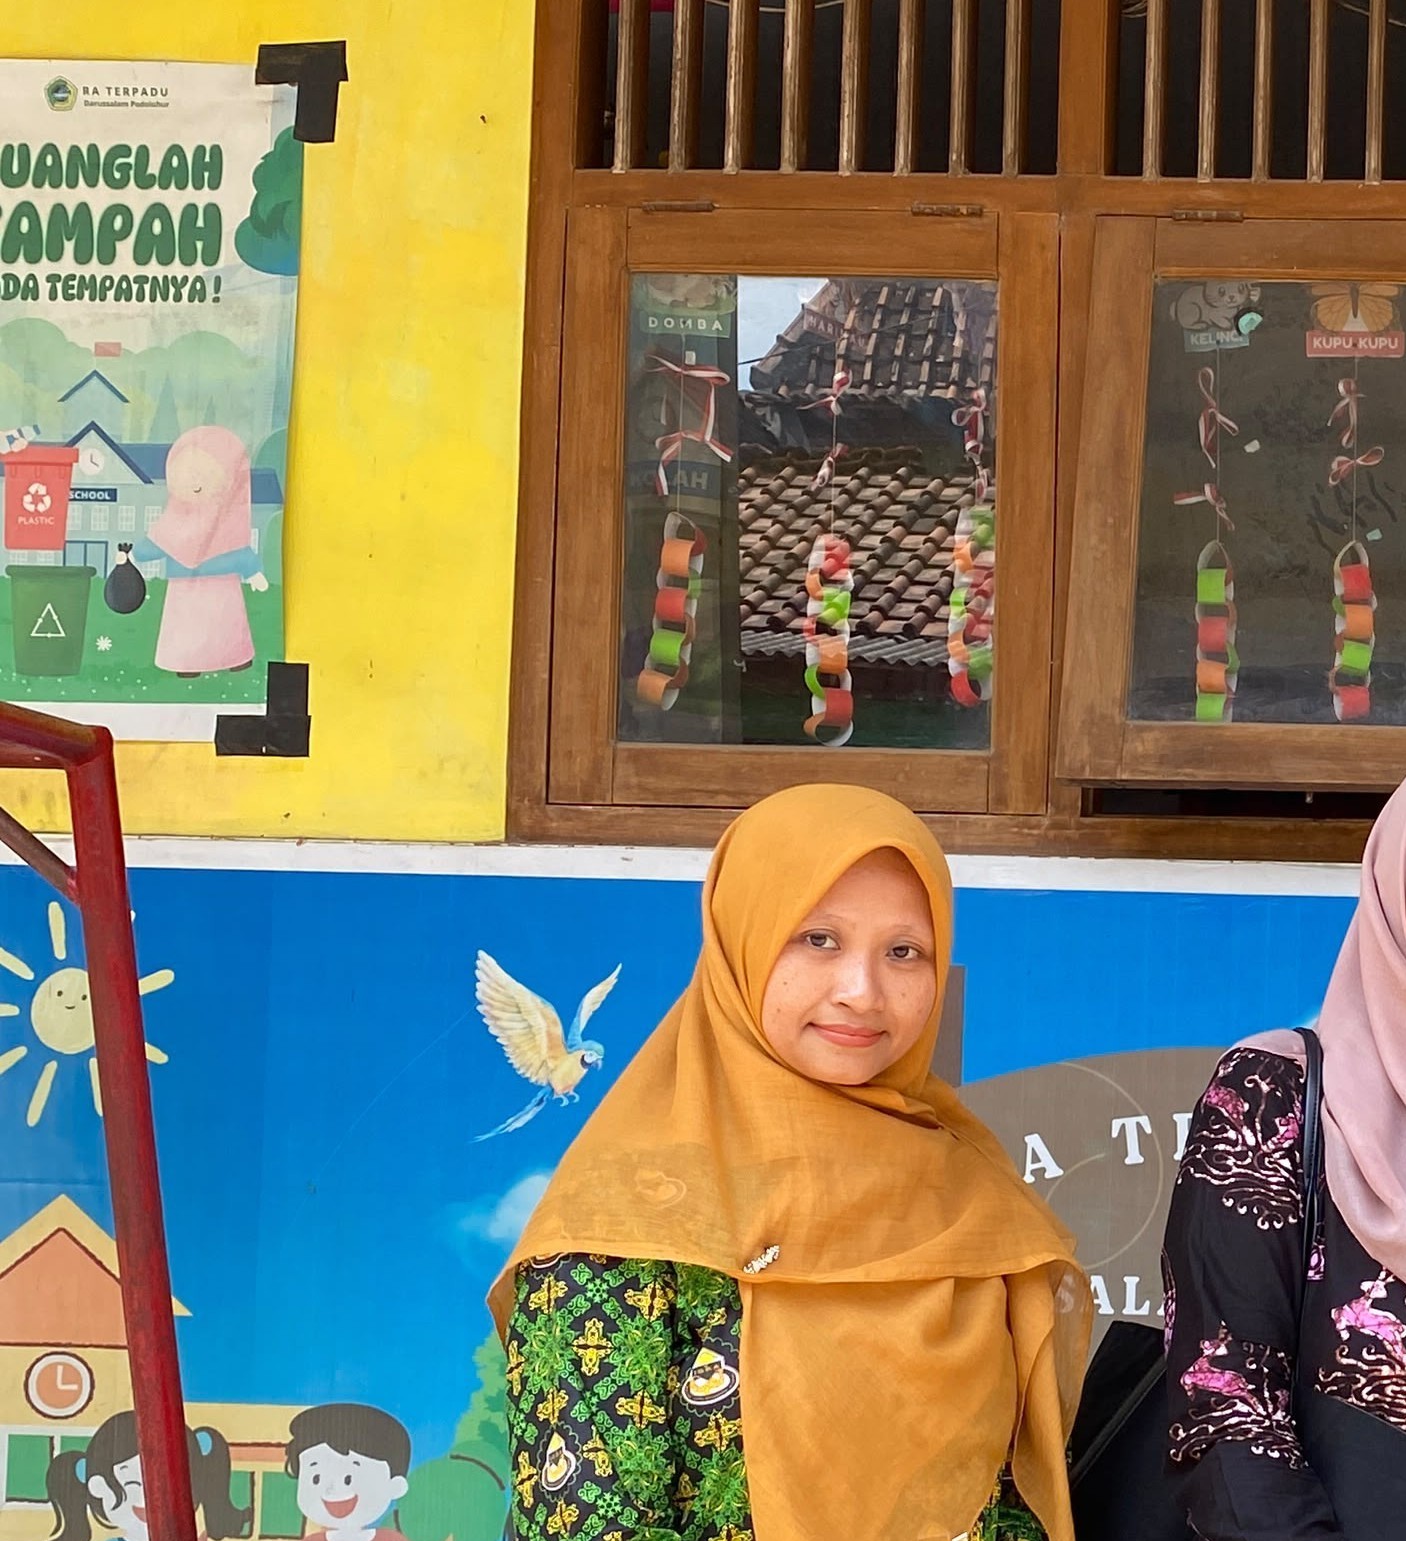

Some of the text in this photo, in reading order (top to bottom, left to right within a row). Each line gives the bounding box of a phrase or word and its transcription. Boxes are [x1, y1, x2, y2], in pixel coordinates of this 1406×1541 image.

[82, 86, 169, 97] RA TERPADU
[0, 200, 223, 267] AMPAH
[45, 273, 207, 303] TEMPATNYA
[648, 316, 723, 331] DOMBA
[1358, 336, 1399, 350] KUPU
[18, 516, 55, 525] PLASTIC
